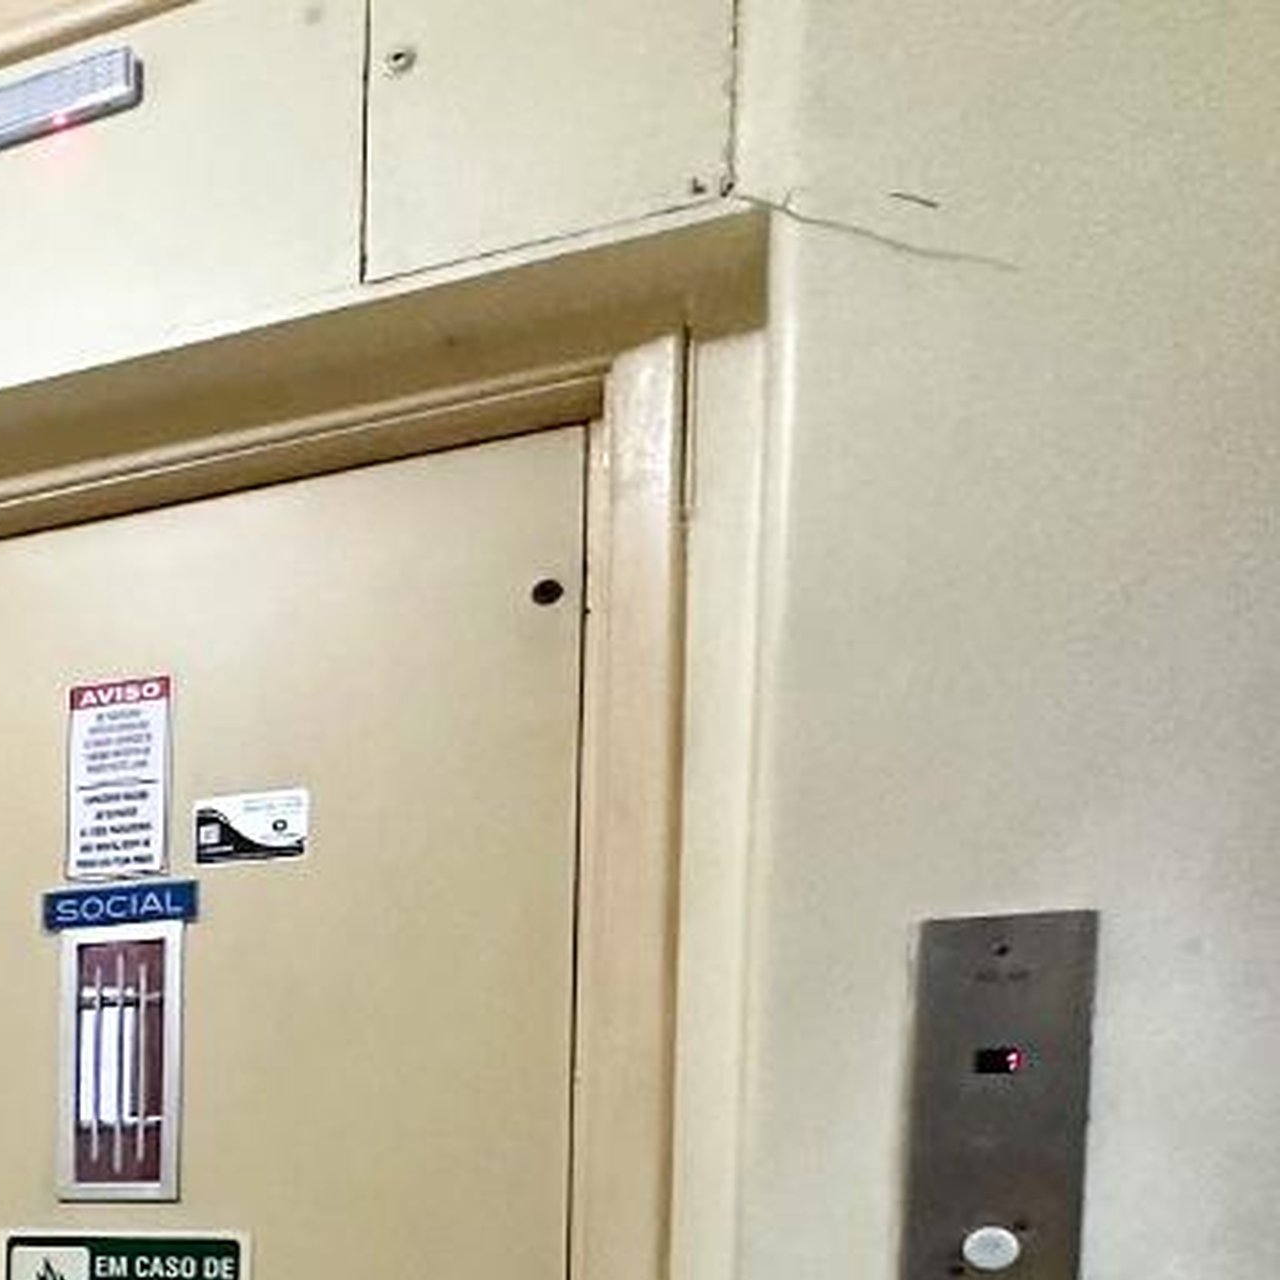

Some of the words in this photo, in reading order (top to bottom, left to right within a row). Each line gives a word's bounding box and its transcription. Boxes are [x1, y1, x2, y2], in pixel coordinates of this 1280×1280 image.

[79, 685, 160, 707] AVISO
[56, 890, 184, 922] SOCIAL
[95, 1256, 128, 1278] EM
[135, 1256, 196, 1278] CASO
[203, 1256, 235, 1280] DE
